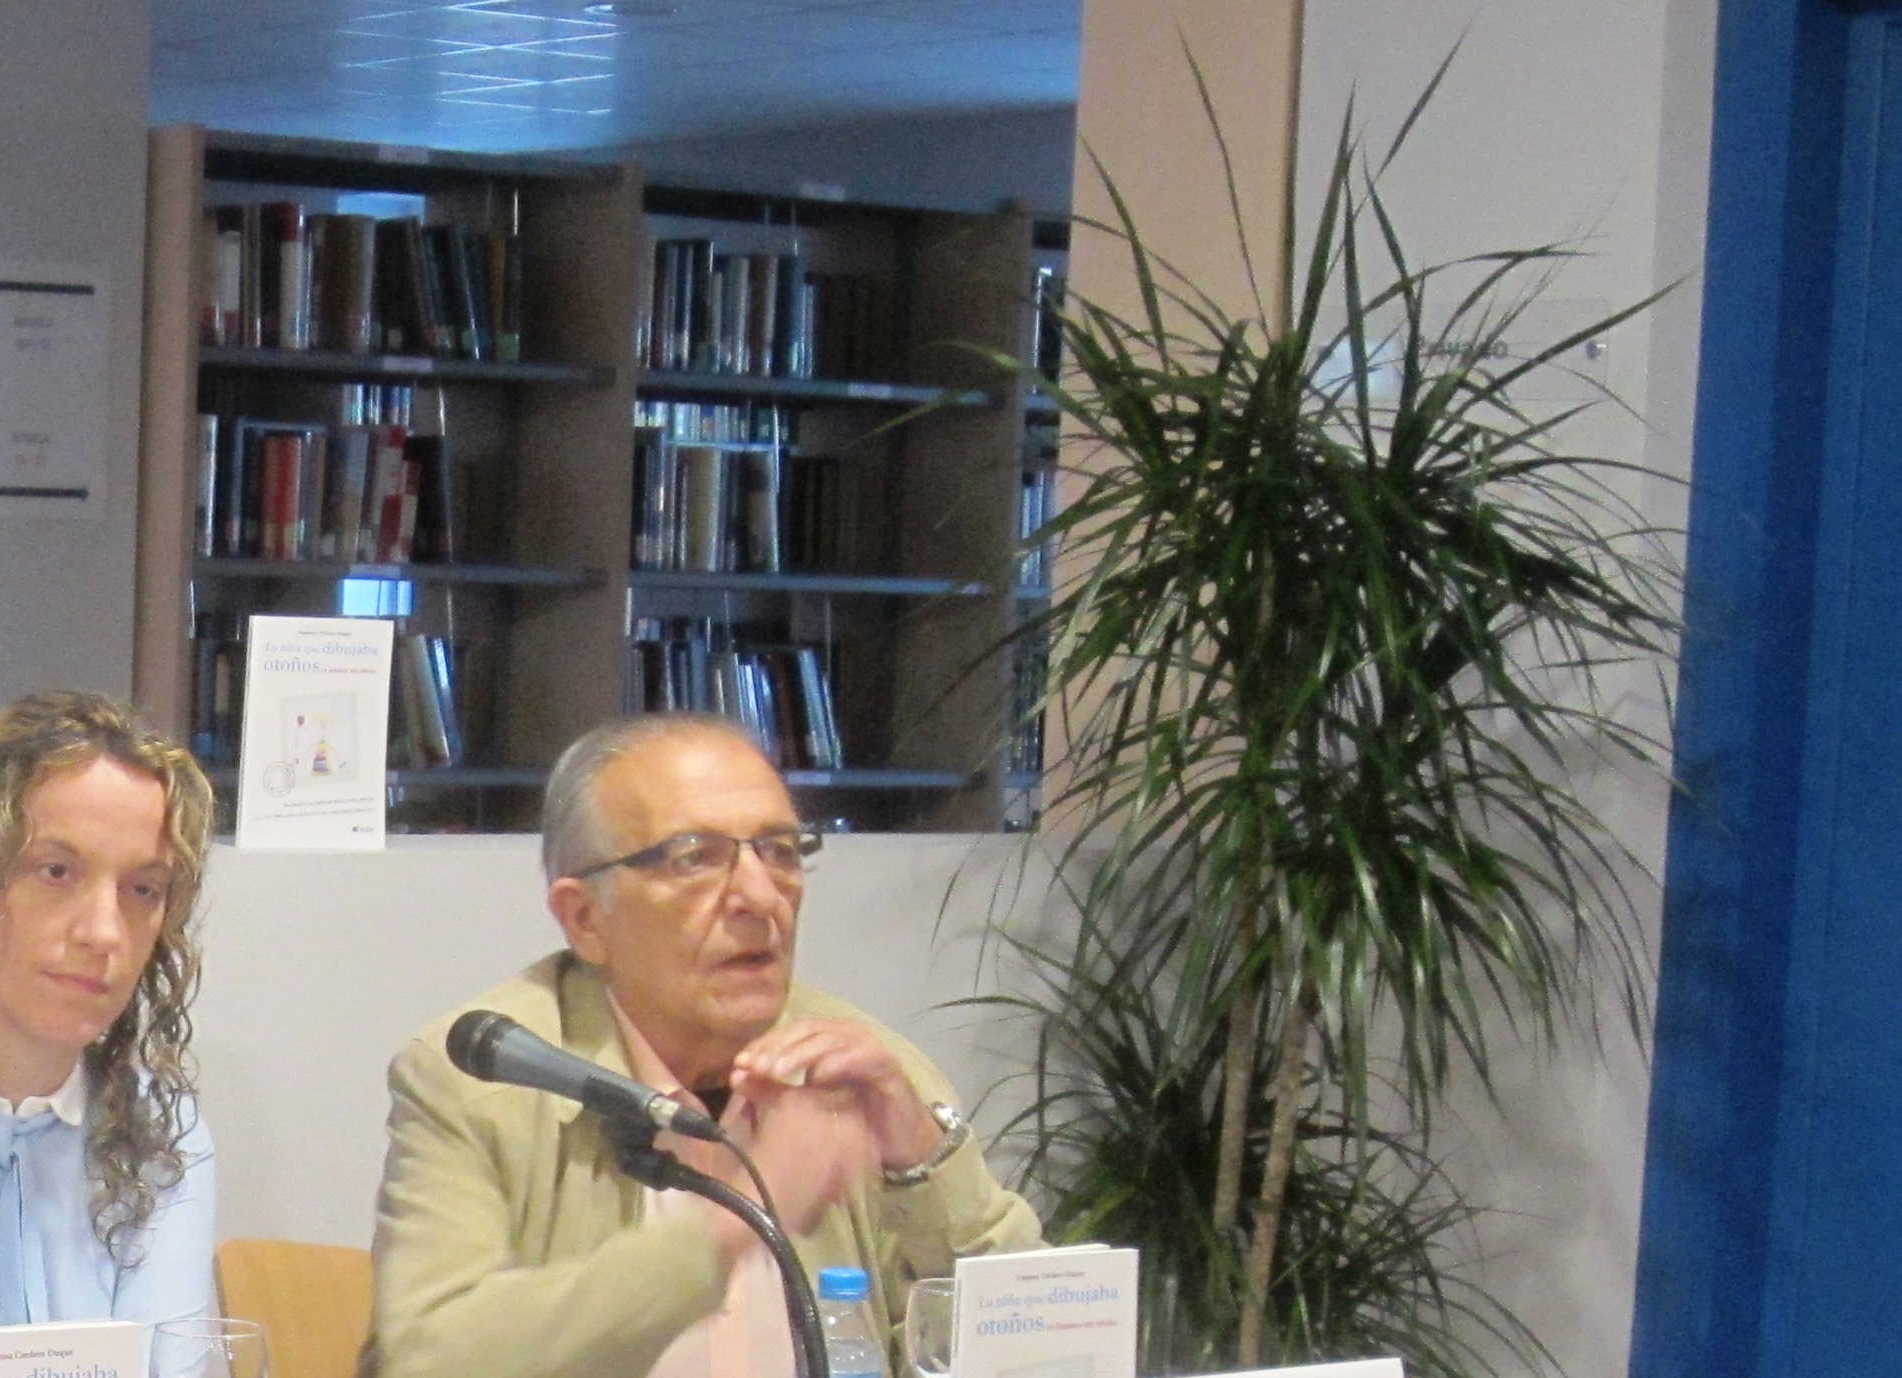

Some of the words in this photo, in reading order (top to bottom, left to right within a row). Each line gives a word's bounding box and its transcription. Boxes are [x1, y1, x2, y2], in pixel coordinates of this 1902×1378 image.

[264, 657, 320, 672] otoños
[1048, 1284, 1119, 1306] dibujaba
[977, 1312, 1044, 1336] otoños
